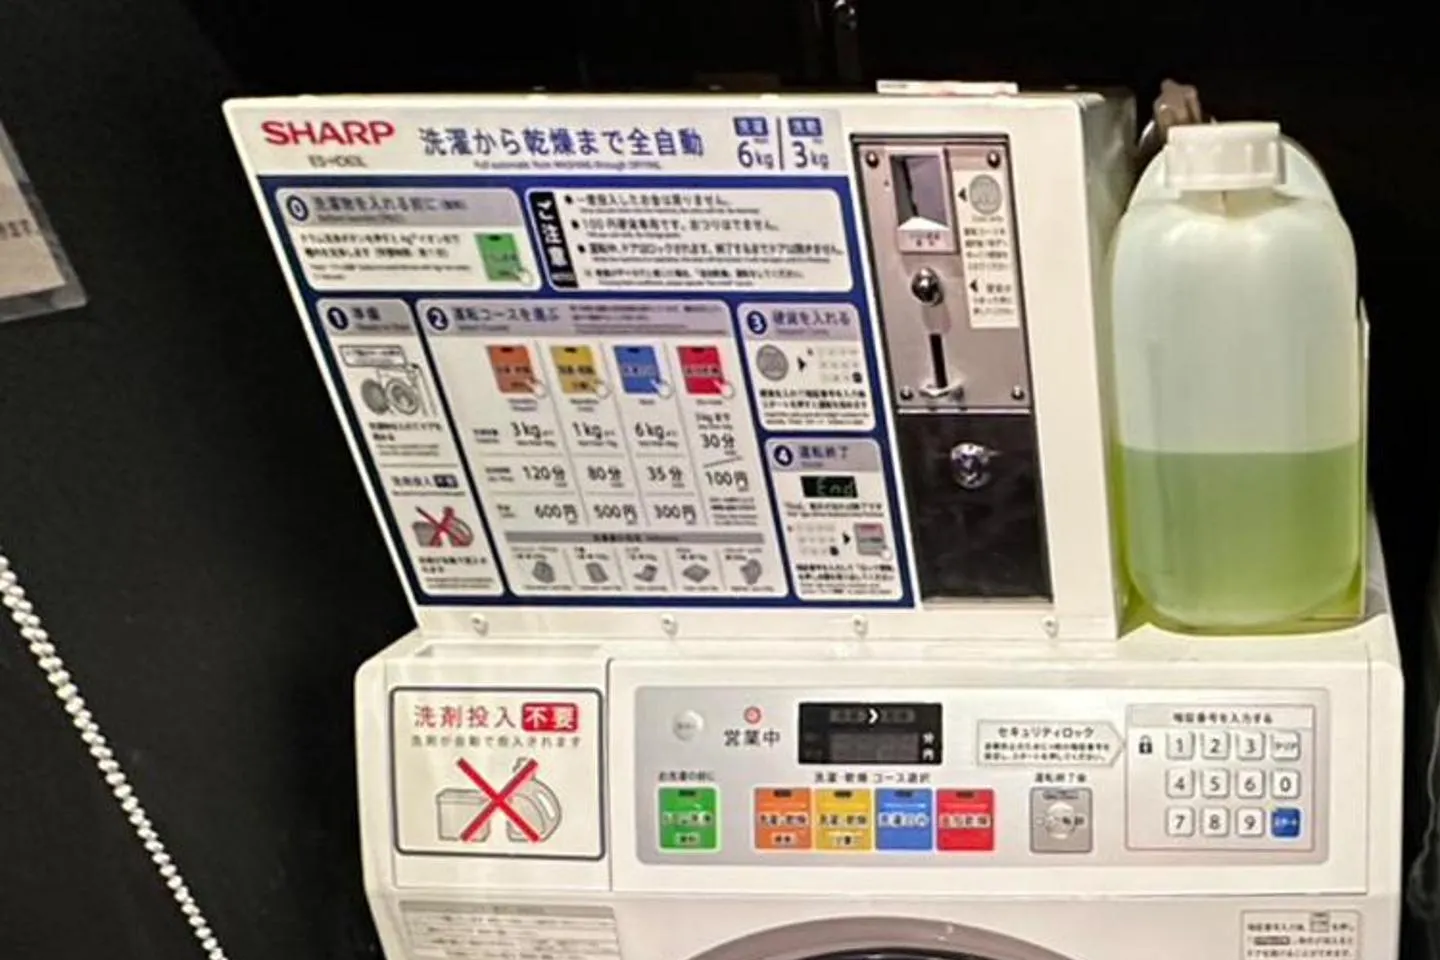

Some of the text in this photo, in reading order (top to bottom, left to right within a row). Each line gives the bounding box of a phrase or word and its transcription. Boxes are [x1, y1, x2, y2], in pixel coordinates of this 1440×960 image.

[261, 120, 395, 146] SHARP
[419, 126, 705, 157] 洗濯から乾燥まで全自動
[522, 465, 566, 483] 120分
[587, 465, 622, 482] 80分
[647, 465, 683, 483] 35分
[705, 470, 749, 489] 100円
[534, 503, 579, 522] 600円
[594, 503, 639, 522] 500円
[654, 503, 698, 522] 300円
[414, 705, 576, 730] 洗剤投入 不要
[724, 728, 781, 747] 営業中
[998, 726, 1094, 738] セキュリティロック
[410, 734, 582, 748] 洗剤が自動で投入されます
[1175, 737, 1184, 753] 1
[1209, 738, 1221, 753] 2
[1246, 738, 1256, 753] 3
[1174, 776, 1185, 791] 4
[1209, 776, 1220, 791] 5
[1244, 777, 1256, 792] 6
[1279, 776, 1291, 792] 0
[1175, 814, 1186, 830] 7
[1209, 814, 1221, 830] 8
[1243, 814, 1256, 830] 9
